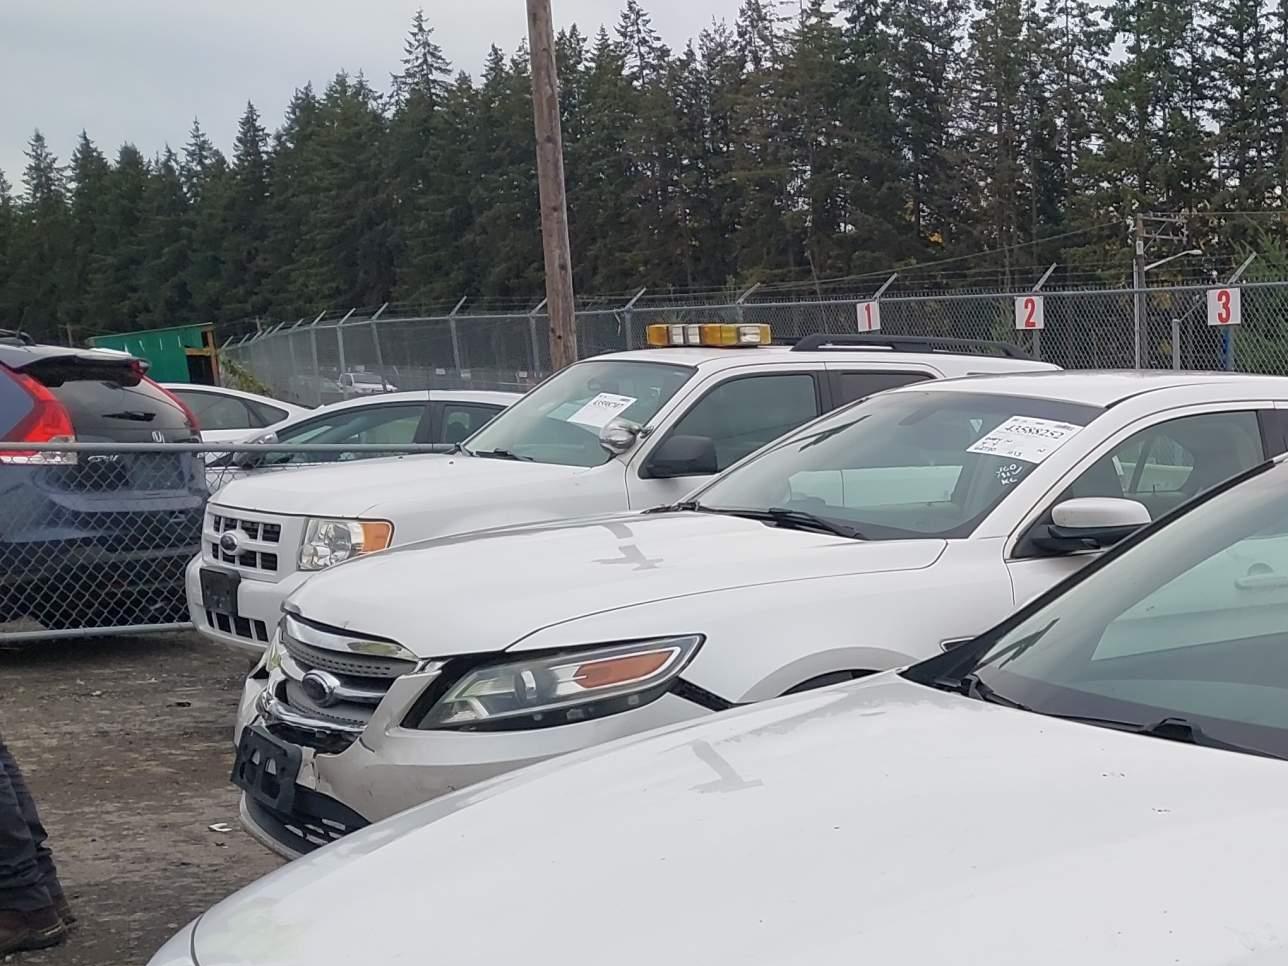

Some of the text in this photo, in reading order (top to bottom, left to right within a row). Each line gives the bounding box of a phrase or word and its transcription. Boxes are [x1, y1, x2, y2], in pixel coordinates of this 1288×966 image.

[864, 305, 872, 329] 1
[1024, 298, 1037, 328] 2
[1217, 289, 1231, 324] 3
